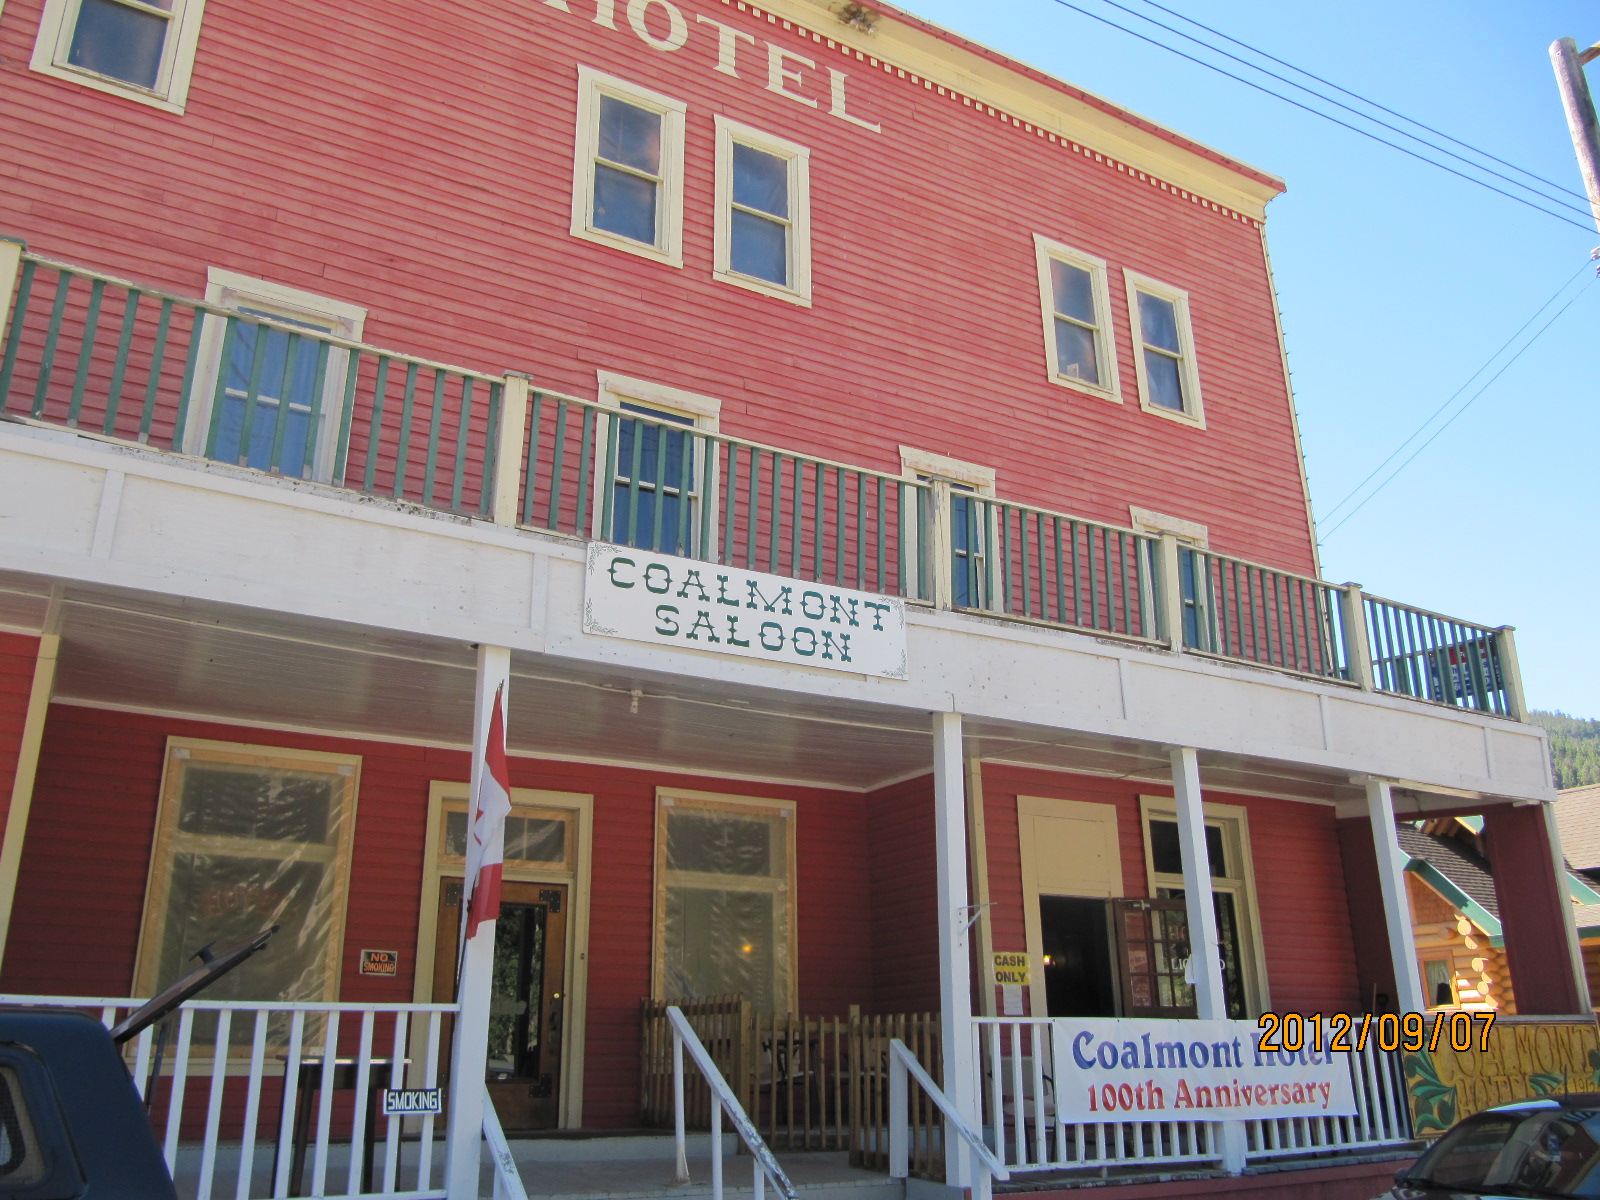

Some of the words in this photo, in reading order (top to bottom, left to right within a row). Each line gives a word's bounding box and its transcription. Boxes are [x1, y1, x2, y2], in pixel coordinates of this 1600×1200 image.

[543, 0, 882, 134] OTEL
[606, 556, 892, 632] COALMONT
[655, 604, 852, 663] SALOON
[363, 961, 395, 973] SMOKING
[370, 952, 389, 962] NO
[994, 955, 1026, 967] CASH
[995, 971, 1026, 983] ONLY
[1071, 1030, 1244, 1070] Coalmont
[387, 1091, 438, 1111] SMOKING
[1087, 1079, 1166, 1112] 100th
[1173, 1077, 1332, 1110] Anniversary
